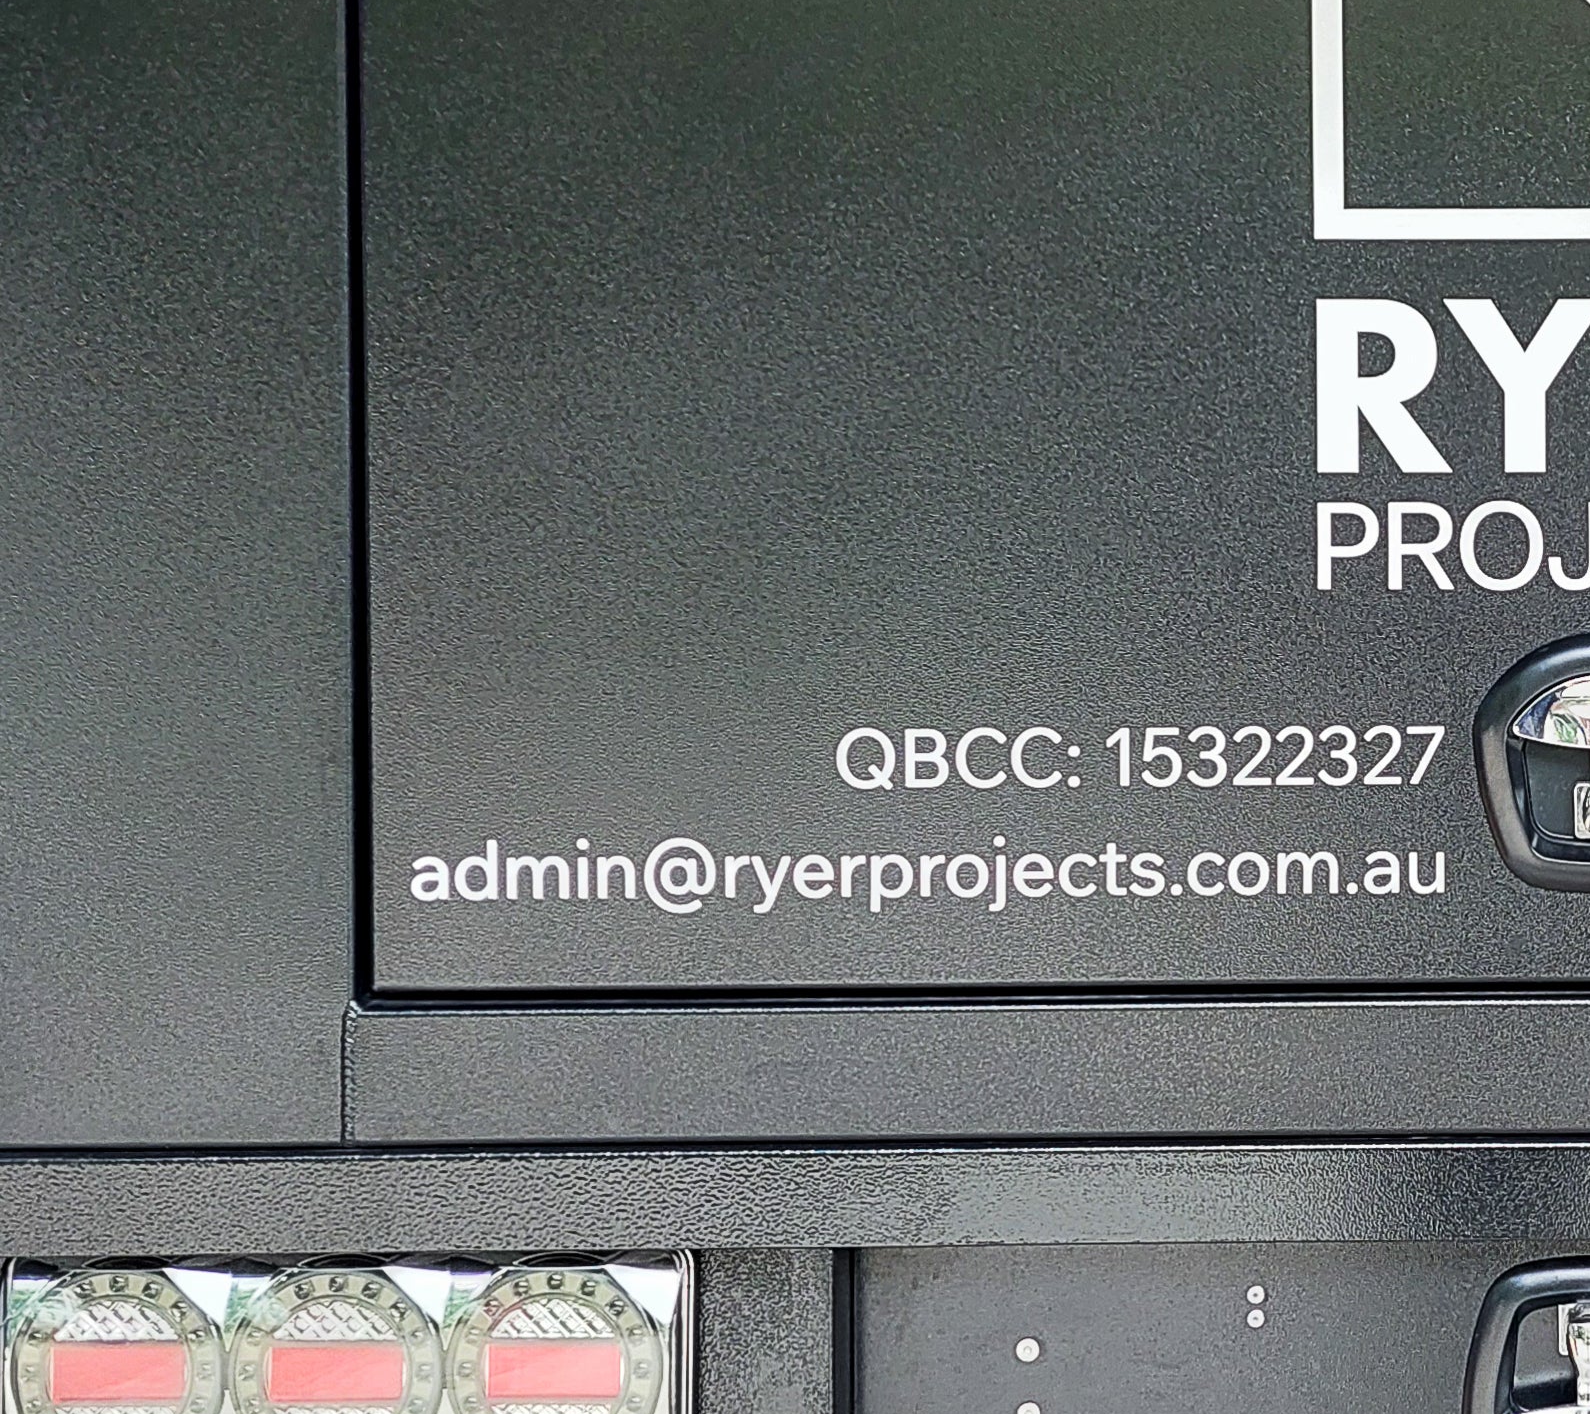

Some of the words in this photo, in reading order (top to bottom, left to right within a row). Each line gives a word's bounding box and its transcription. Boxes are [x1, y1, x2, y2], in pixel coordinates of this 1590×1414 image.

[834, 725, 1082, 790] QBCC:
[1105, 725, 1446, 788] 15322327
[410, 834, 1446, 915] admin@ryerprojects.com.au
